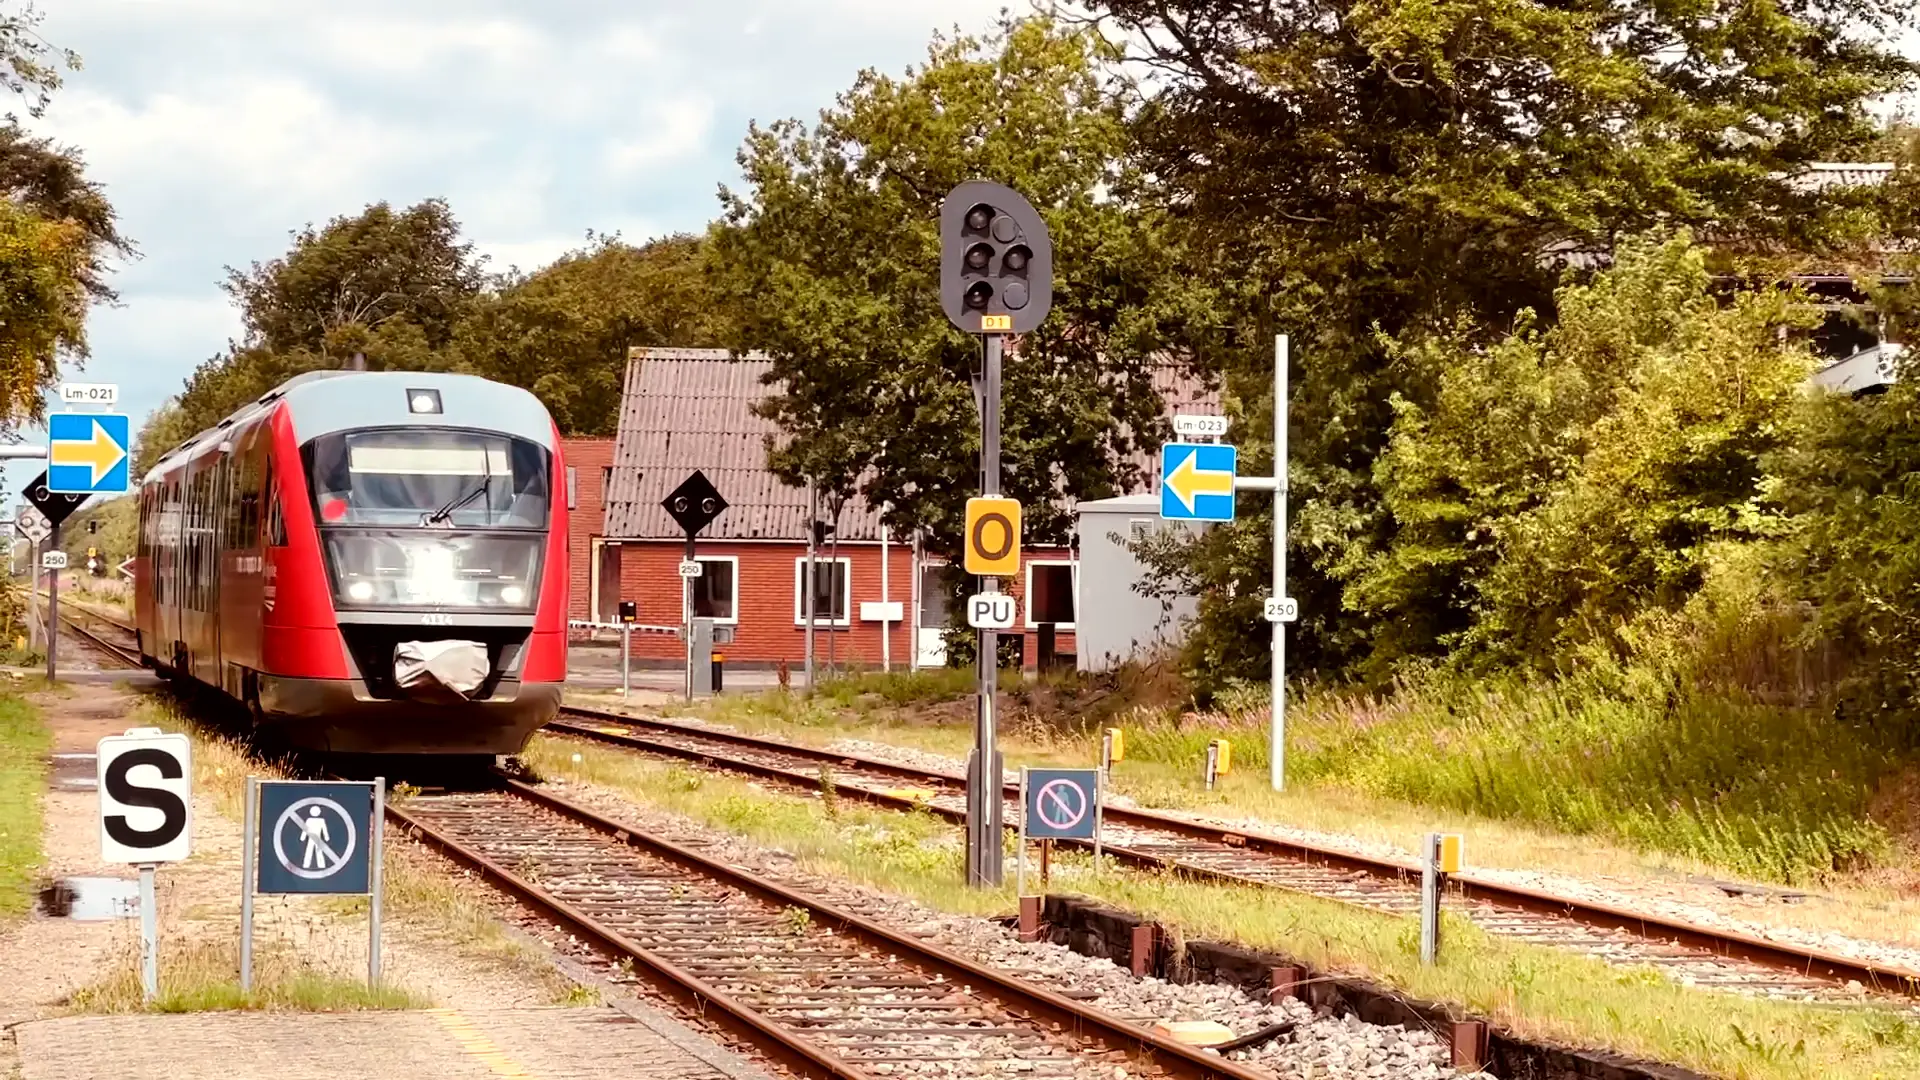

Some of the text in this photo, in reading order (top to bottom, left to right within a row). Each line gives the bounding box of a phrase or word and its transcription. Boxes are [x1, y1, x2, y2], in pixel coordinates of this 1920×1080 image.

[65, 387, 112, 399] Lm-021
[1177, 419, 1222, 431] Lm-023
[45, 556, 65, 565] 250
[681, 565, 699, 574] 250
[975, 601, 1009, 622] PU
[1268, 604, 1294, 615] 250
[104, 748, 186, 849] S
